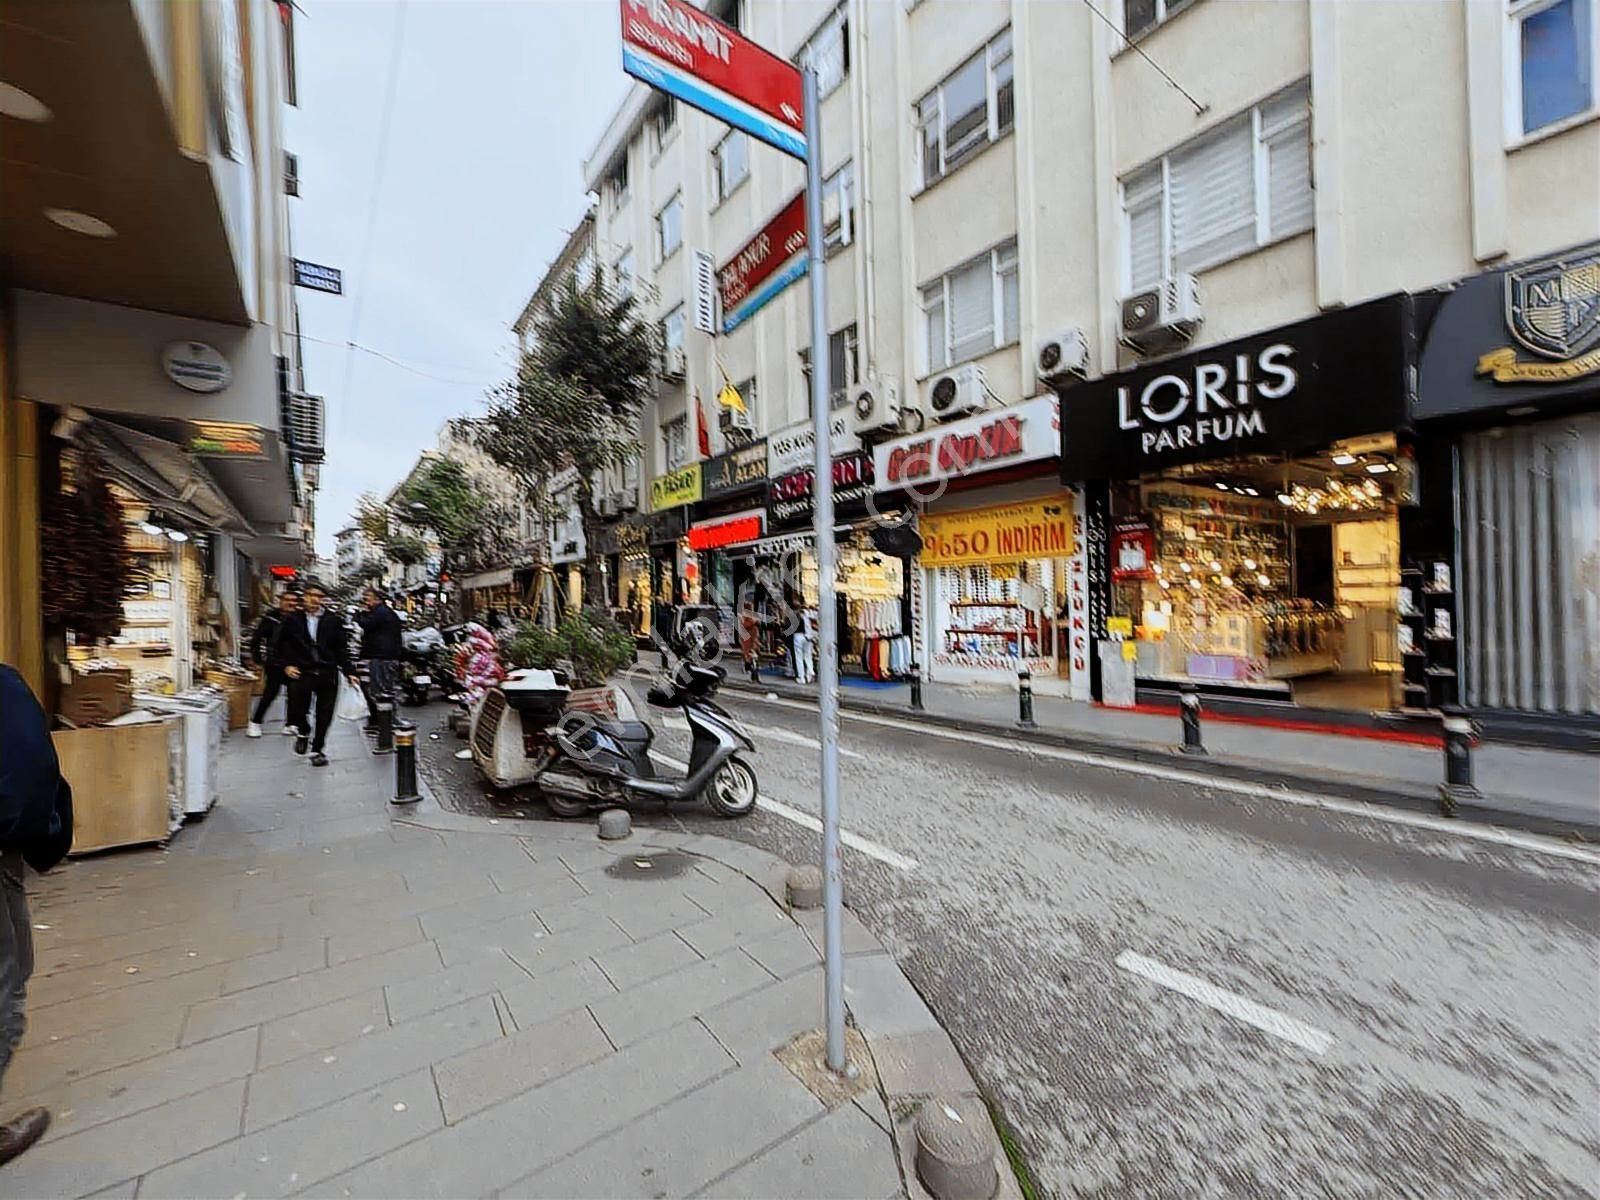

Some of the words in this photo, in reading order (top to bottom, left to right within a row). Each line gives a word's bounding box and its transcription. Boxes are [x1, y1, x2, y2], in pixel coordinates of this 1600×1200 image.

[1117, 344, 1296, 430] LORIS
[1141, 410, 1267, 454] PARFUM
[925, 528, 990, 558] %50
[995, 516, 1067, 555] İNDİRİM
